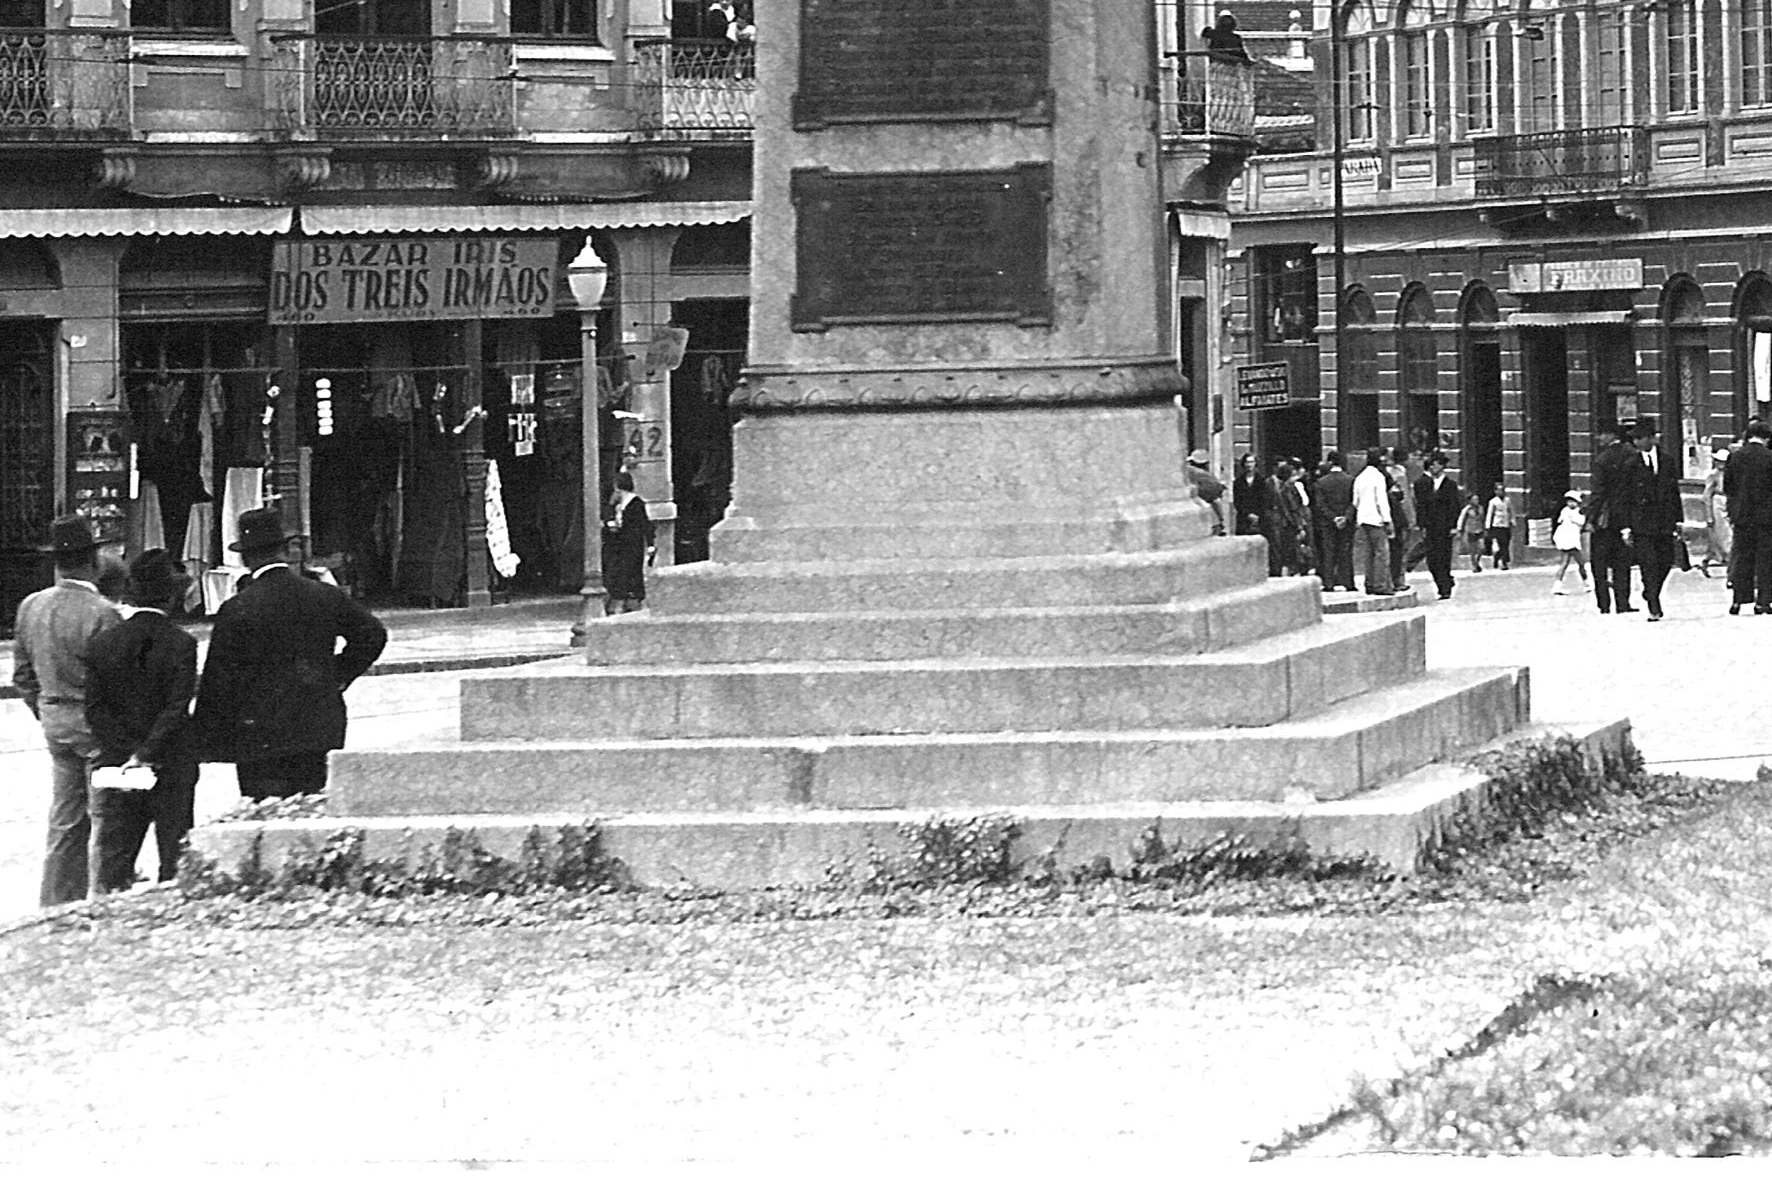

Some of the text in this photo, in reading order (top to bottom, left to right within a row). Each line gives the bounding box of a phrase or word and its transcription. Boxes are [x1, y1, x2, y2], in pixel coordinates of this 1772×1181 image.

[1340, 159, 1380, 174] ARADA
[312, 241, 517, 267] BAZAR IRIS
[272, 263, 550, 312] DOS TREIS IRMÃOS
